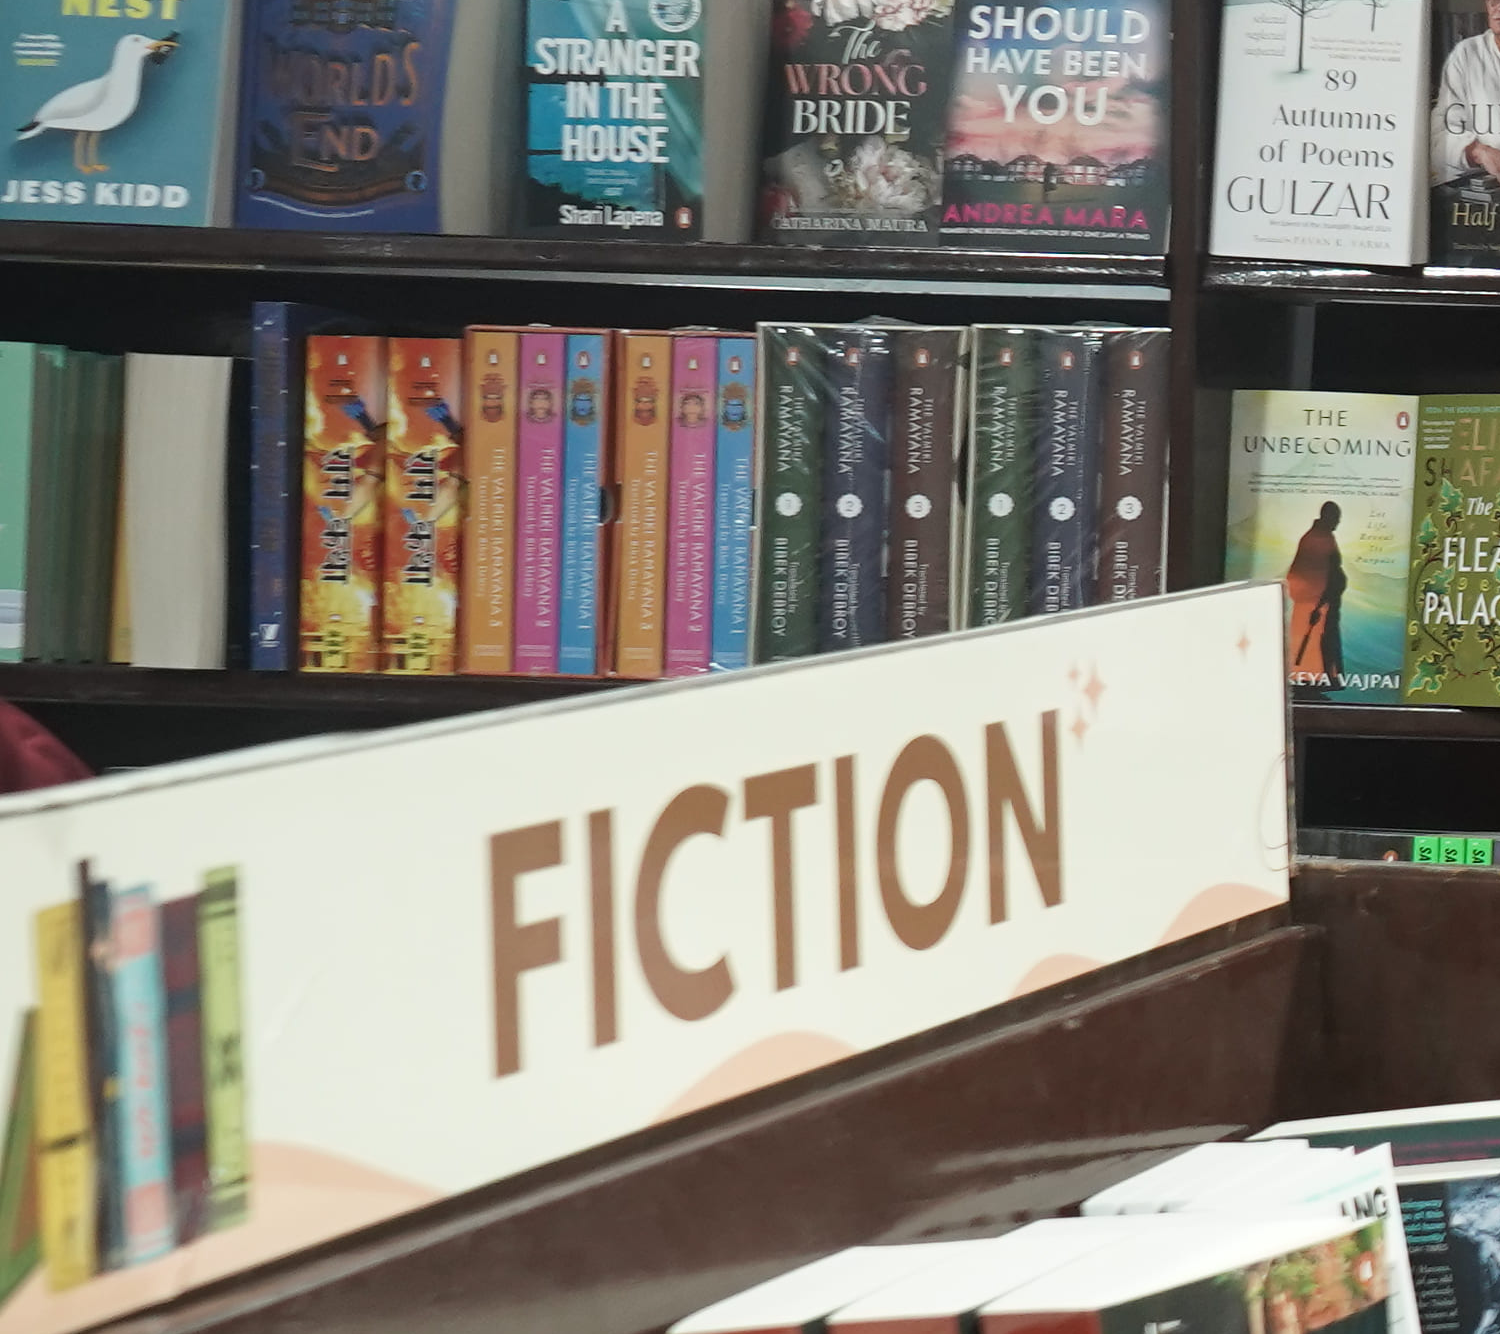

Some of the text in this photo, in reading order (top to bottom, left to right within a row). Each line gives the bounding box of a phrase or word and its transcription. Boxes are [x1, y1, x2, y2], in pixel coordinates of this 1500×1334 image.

[606, 0, 629, 33] A
[970, 5, 1150, 42] SHOULD
[535, 38, 700, 77] STRANGER
[965, 49, 1147, 80] HAVE BEEN
[1325, 69, 1358, 93] 89
[566, 81, 664, 121] IN THE
[998, 85, 1108, 126] YOU
[1272, 104, 1397, 132] Autumns
[561, 126, 669, 164] HOUSE
[1259, 139, 1395, 169] of Poems
[2, 179, 188, 209] JESS KIDD
[1227, 176, 1390, 222] GULZAR
[489, 708, 1064, 1081] FICTION
